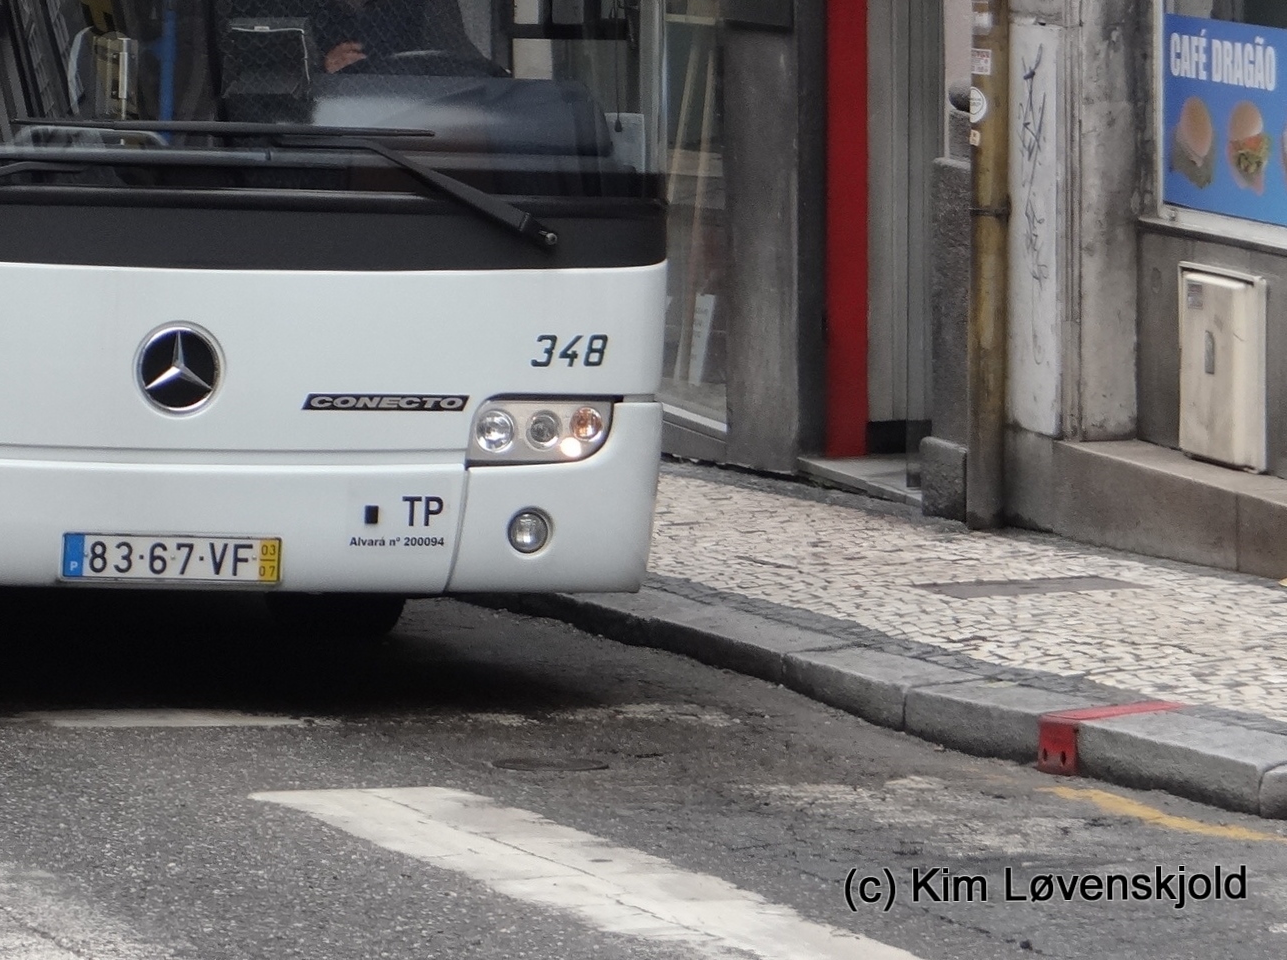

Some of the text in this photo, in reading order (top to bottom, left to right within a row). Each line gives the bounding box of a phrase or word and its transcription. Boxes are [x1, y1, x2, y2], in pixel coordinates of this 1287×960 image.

[1170, 28, 1276, 91] CAFÉ DRAGÃO
[530, 334, 608, 367] 348
[310, 396, 463, 410] CONECTO
[402, 496, 444, 527] TP
[349, 536, 386, 547] Alvará
[404, 537, 444, 547] 200094
[261, 544, 277, 557] 03
[69, 560, 79, 572] P
[259, 565, 276, 578] 07
